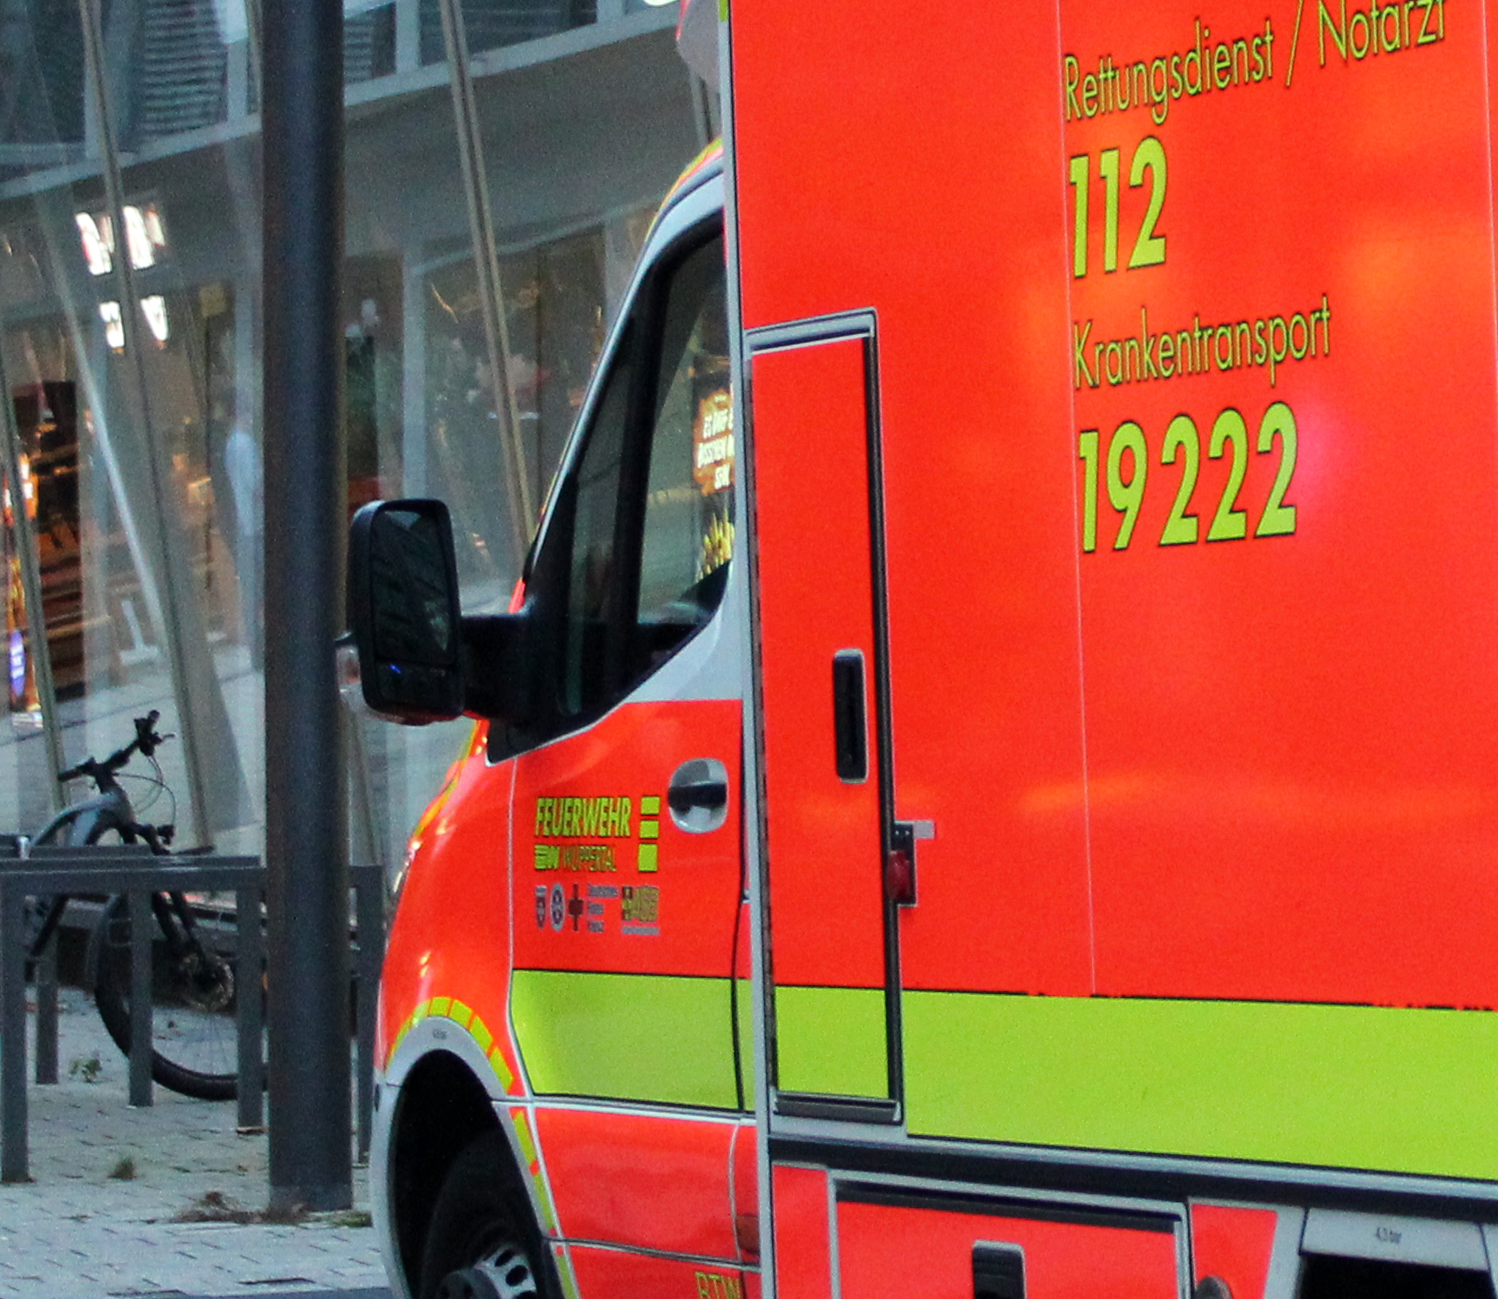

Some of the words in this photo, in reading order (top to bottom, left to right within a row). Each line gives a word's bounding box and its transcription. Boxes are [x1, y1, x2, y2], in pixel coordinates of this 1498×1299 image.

[1063, 18, 1275, 125] Rettungsdienst
[1068, 135, 1169, 279] 112
[1072, 291, 1332, 390] Krankentransport
[1077, 400, 1299, 554] 19222
[535, 795, 631, 838] FEUERWEHR
